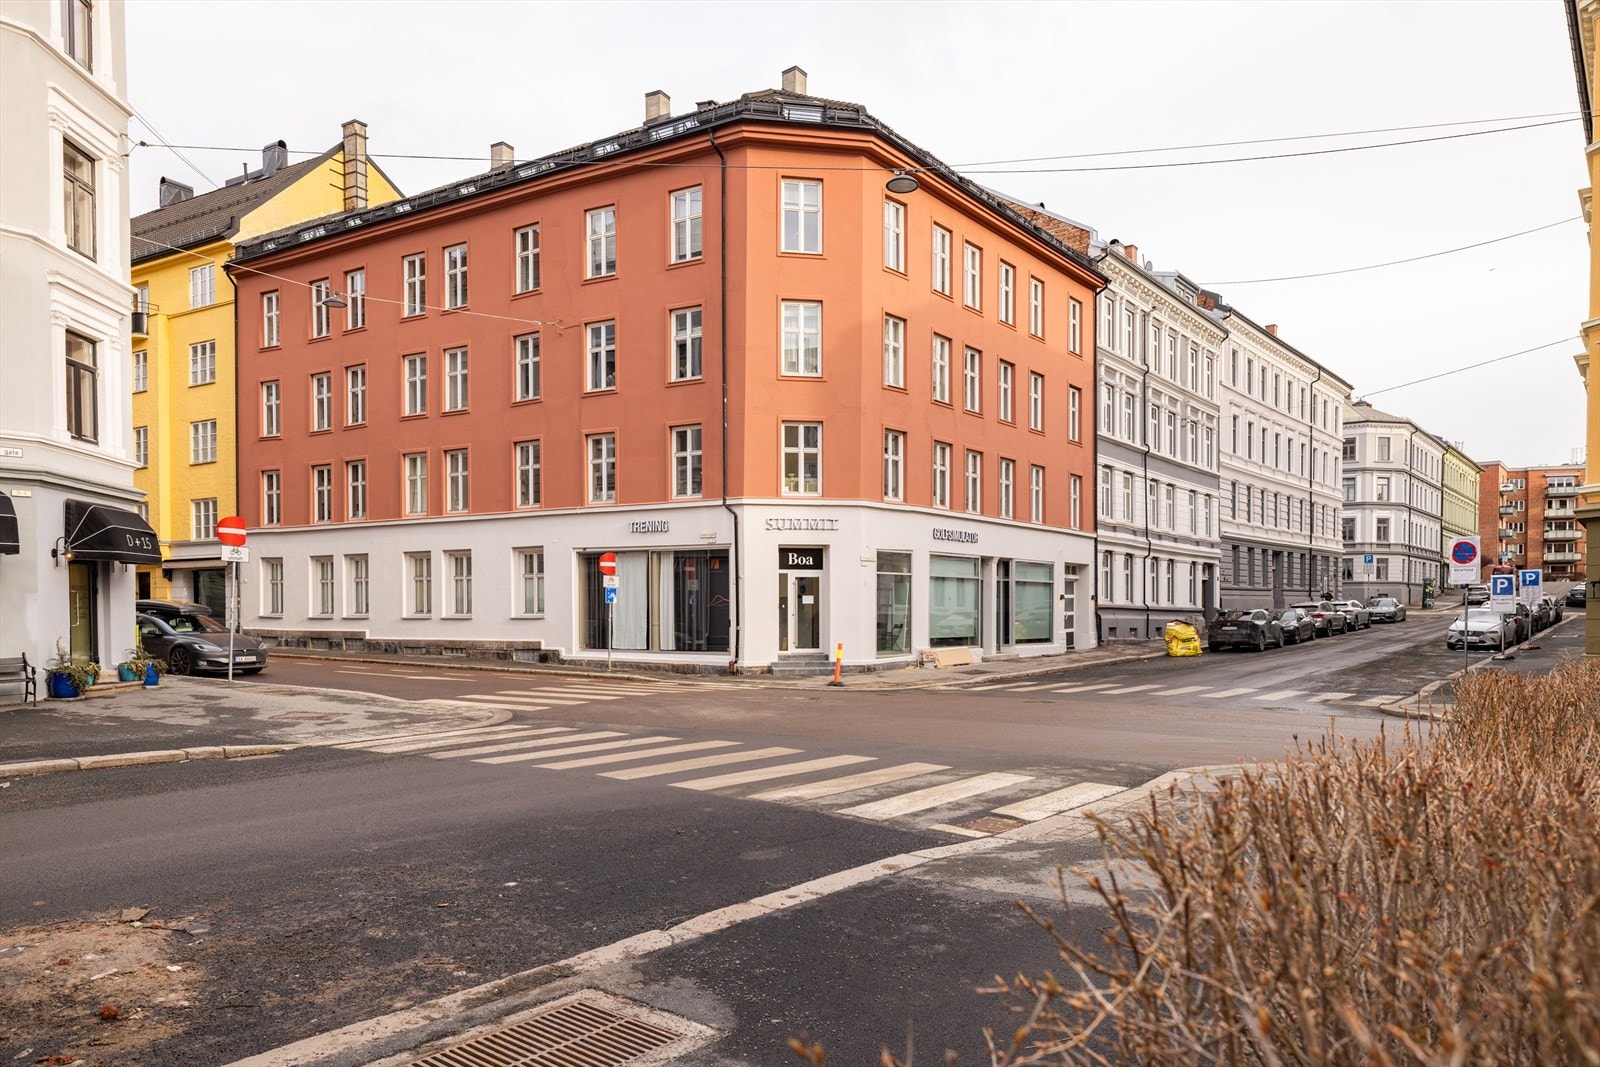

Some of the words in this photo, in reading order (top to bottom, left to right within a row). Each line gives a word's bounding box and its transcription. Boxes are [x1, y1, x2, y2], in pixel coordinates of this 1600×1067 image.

[629, 520, 669, 533] TRENING
[766, 518, 839, 531] SUMMIT
[788, 552, 813, 566] Boa
[1525, 572, 1536, 585] P
[1496, 578, 1509, 594] P
